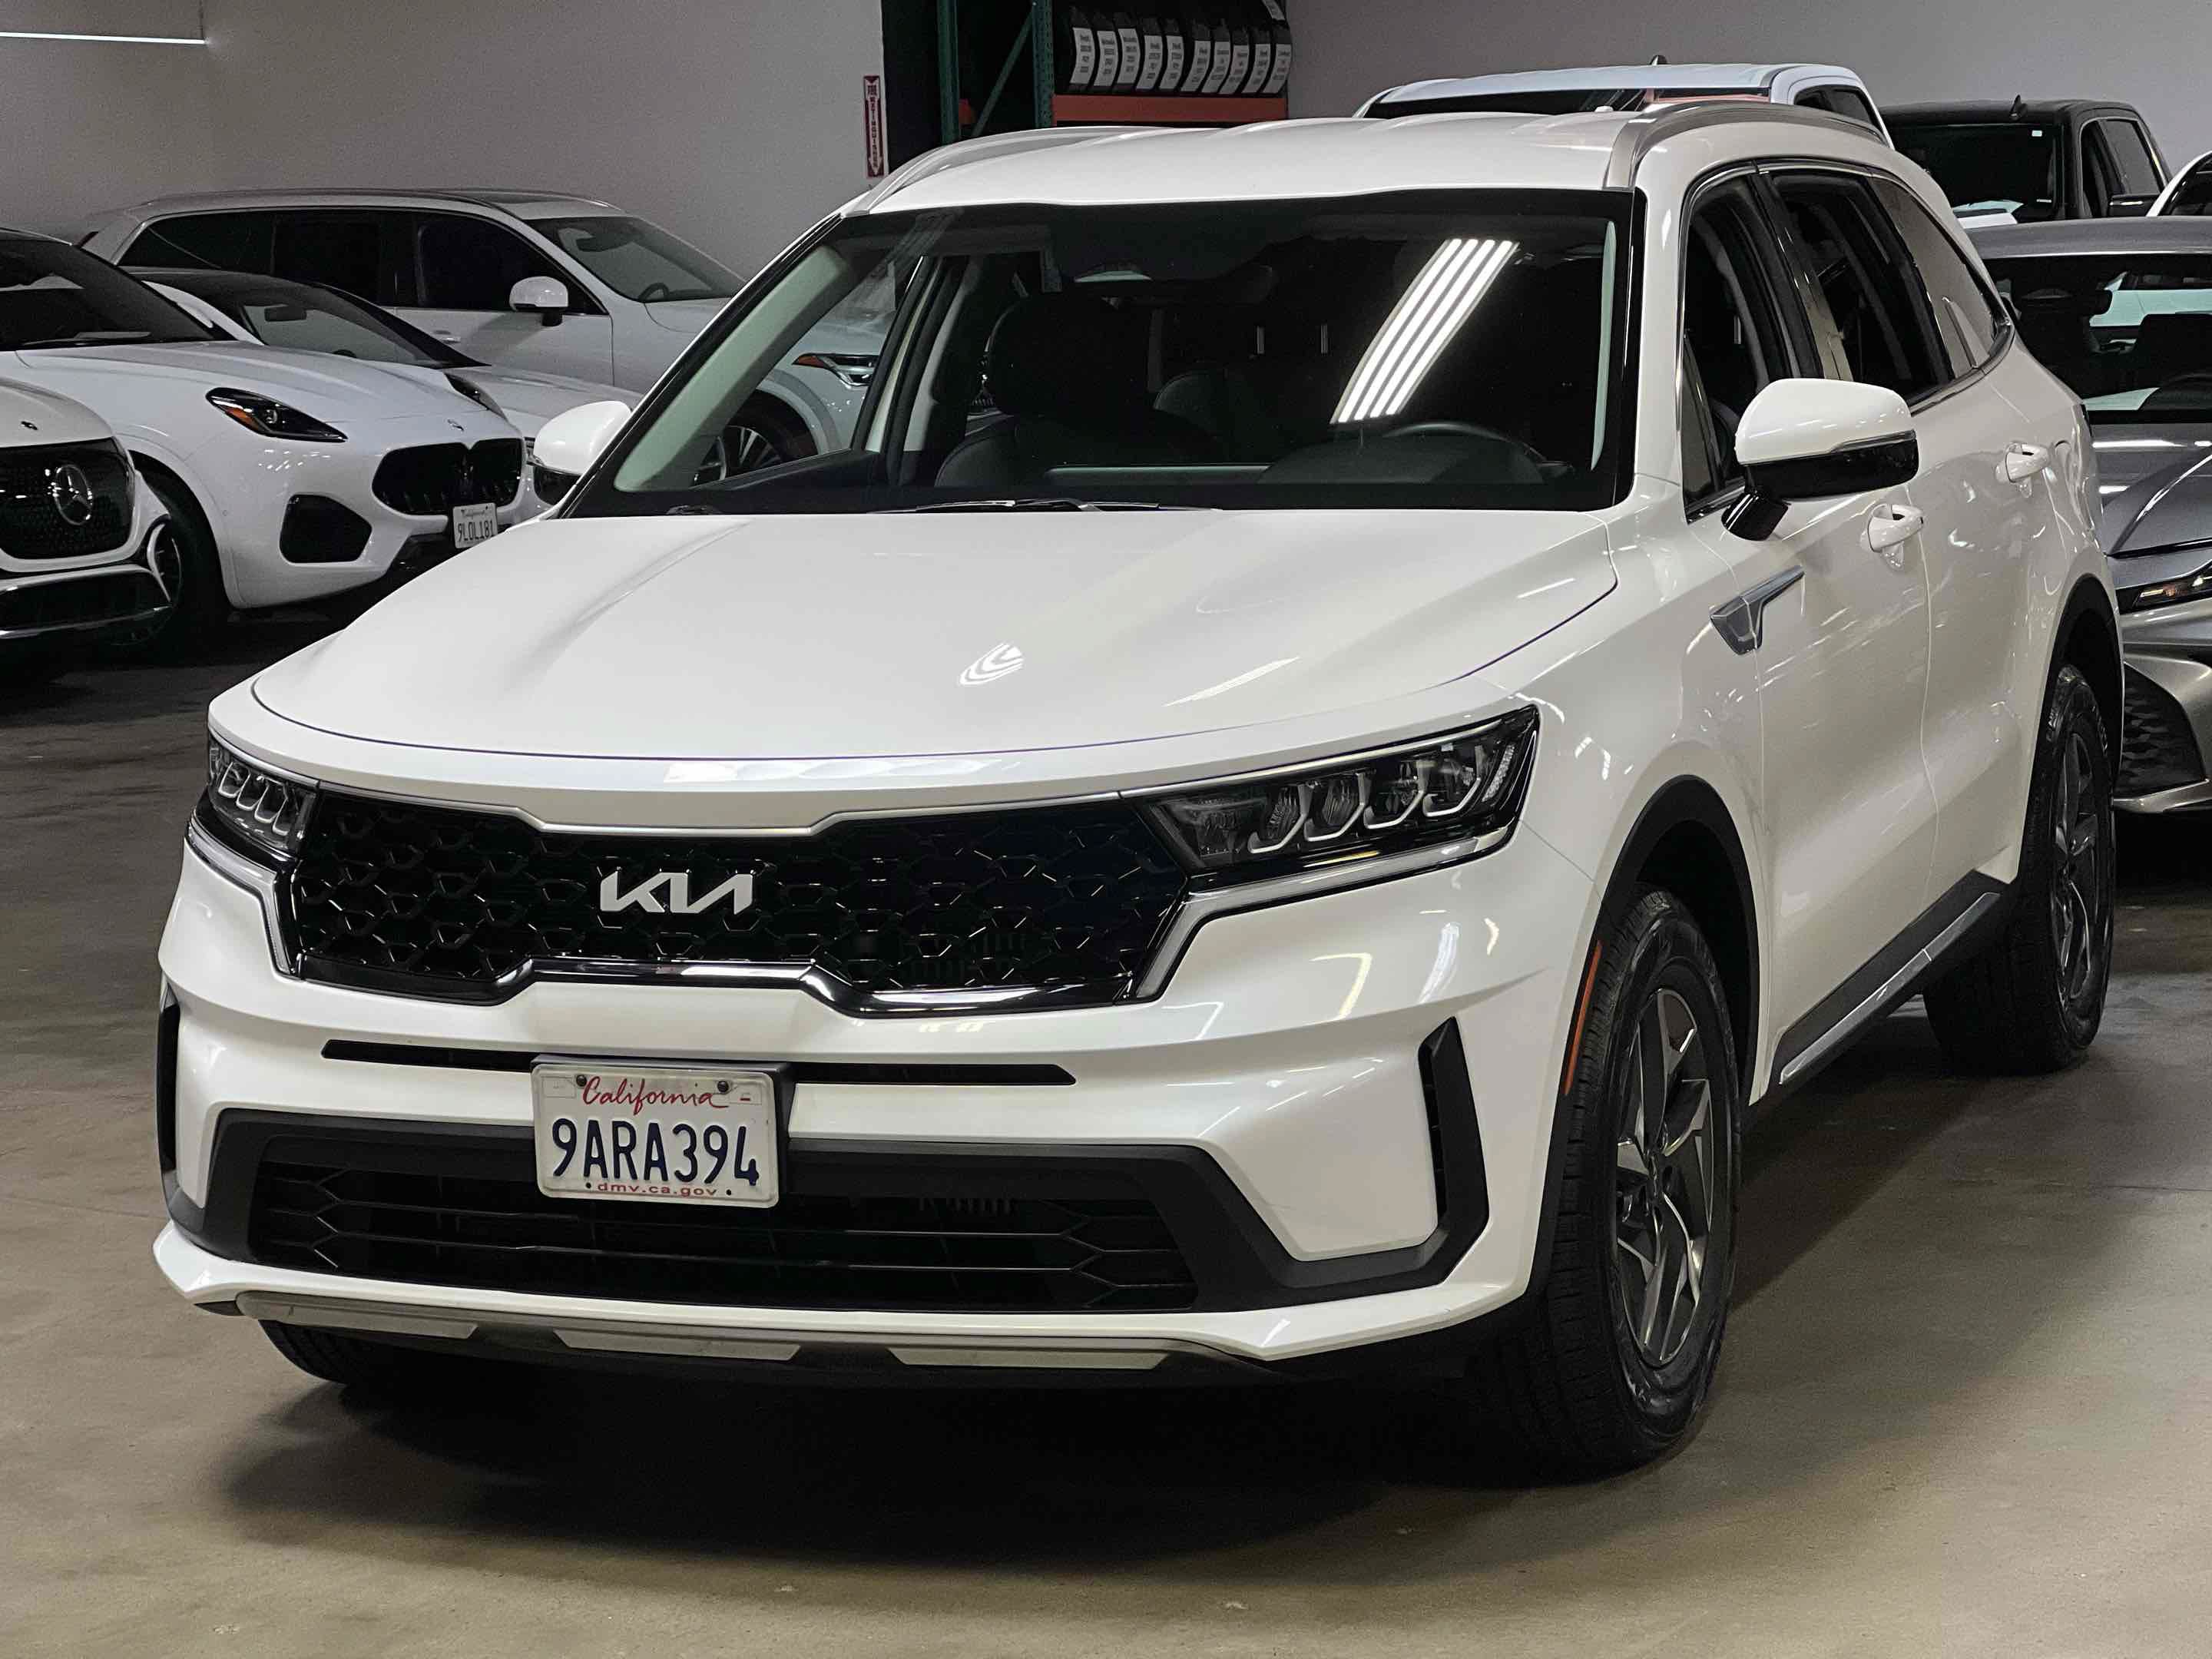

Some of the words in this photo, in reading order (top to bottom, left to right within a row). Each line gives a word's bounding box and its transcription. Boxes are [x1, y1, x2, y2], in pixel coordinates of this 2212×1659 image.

[582, 1076, 729, 1115] California
[551, 1118, 760, 1186] 9ARA394
[597, 1183, 717, 1197] dmv.ca.gov
